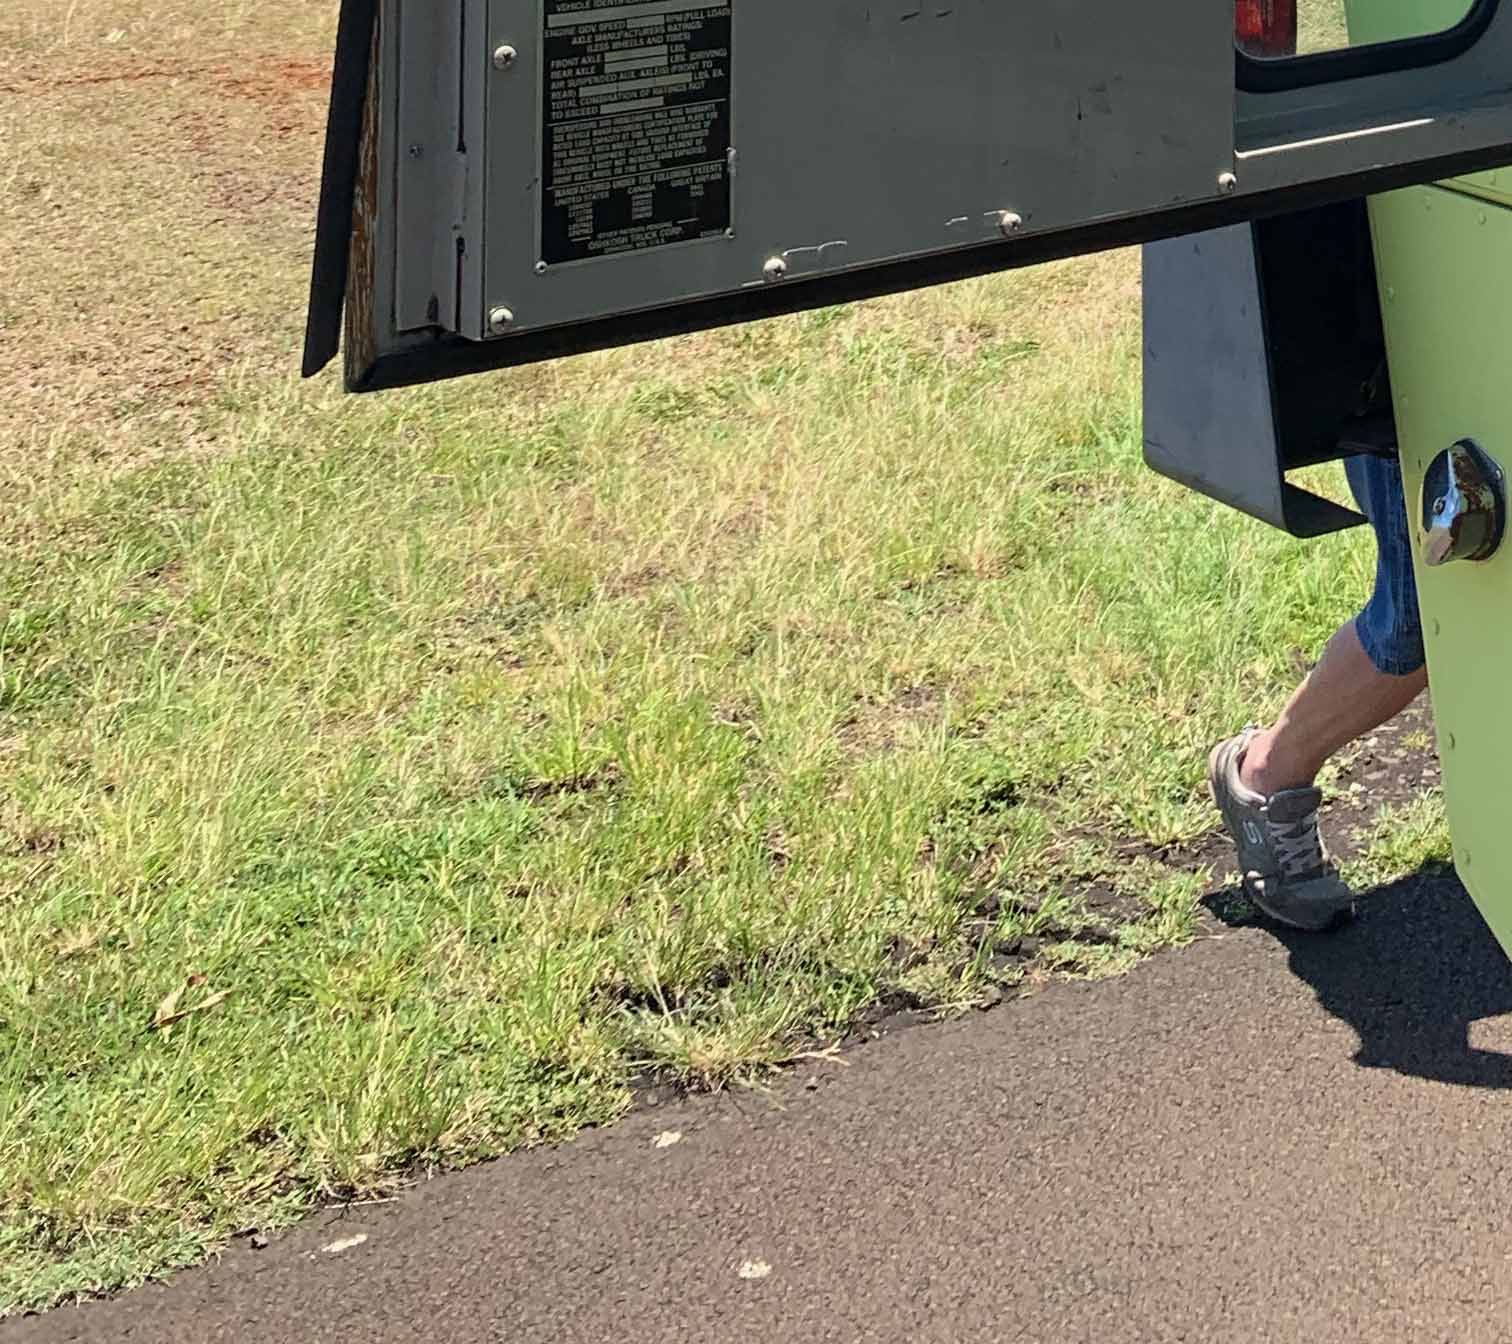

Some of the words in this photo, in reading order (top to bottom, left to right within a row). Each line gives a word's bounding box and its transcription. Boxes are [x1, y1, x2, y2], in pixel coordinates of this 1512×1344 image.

[556, 1, 590, 12] VEHICLE
[647, 35, 663, 44] AND
[551, 57, 579, 68] FRONT
[581, 54, 601, 64] AXLE
[551, 69, 573, 80] REAR
[576, 67, 596, 76] AXLE
[551, 81, 565, 90] AIR
[702, 61, 713, 69] TO
[552, 98, 578, 109] TOTAL
[552, 111, 564, 120] TO
[564, 107, 599, 118] EXCEED
[627, 184, 656, 194] CANADA
